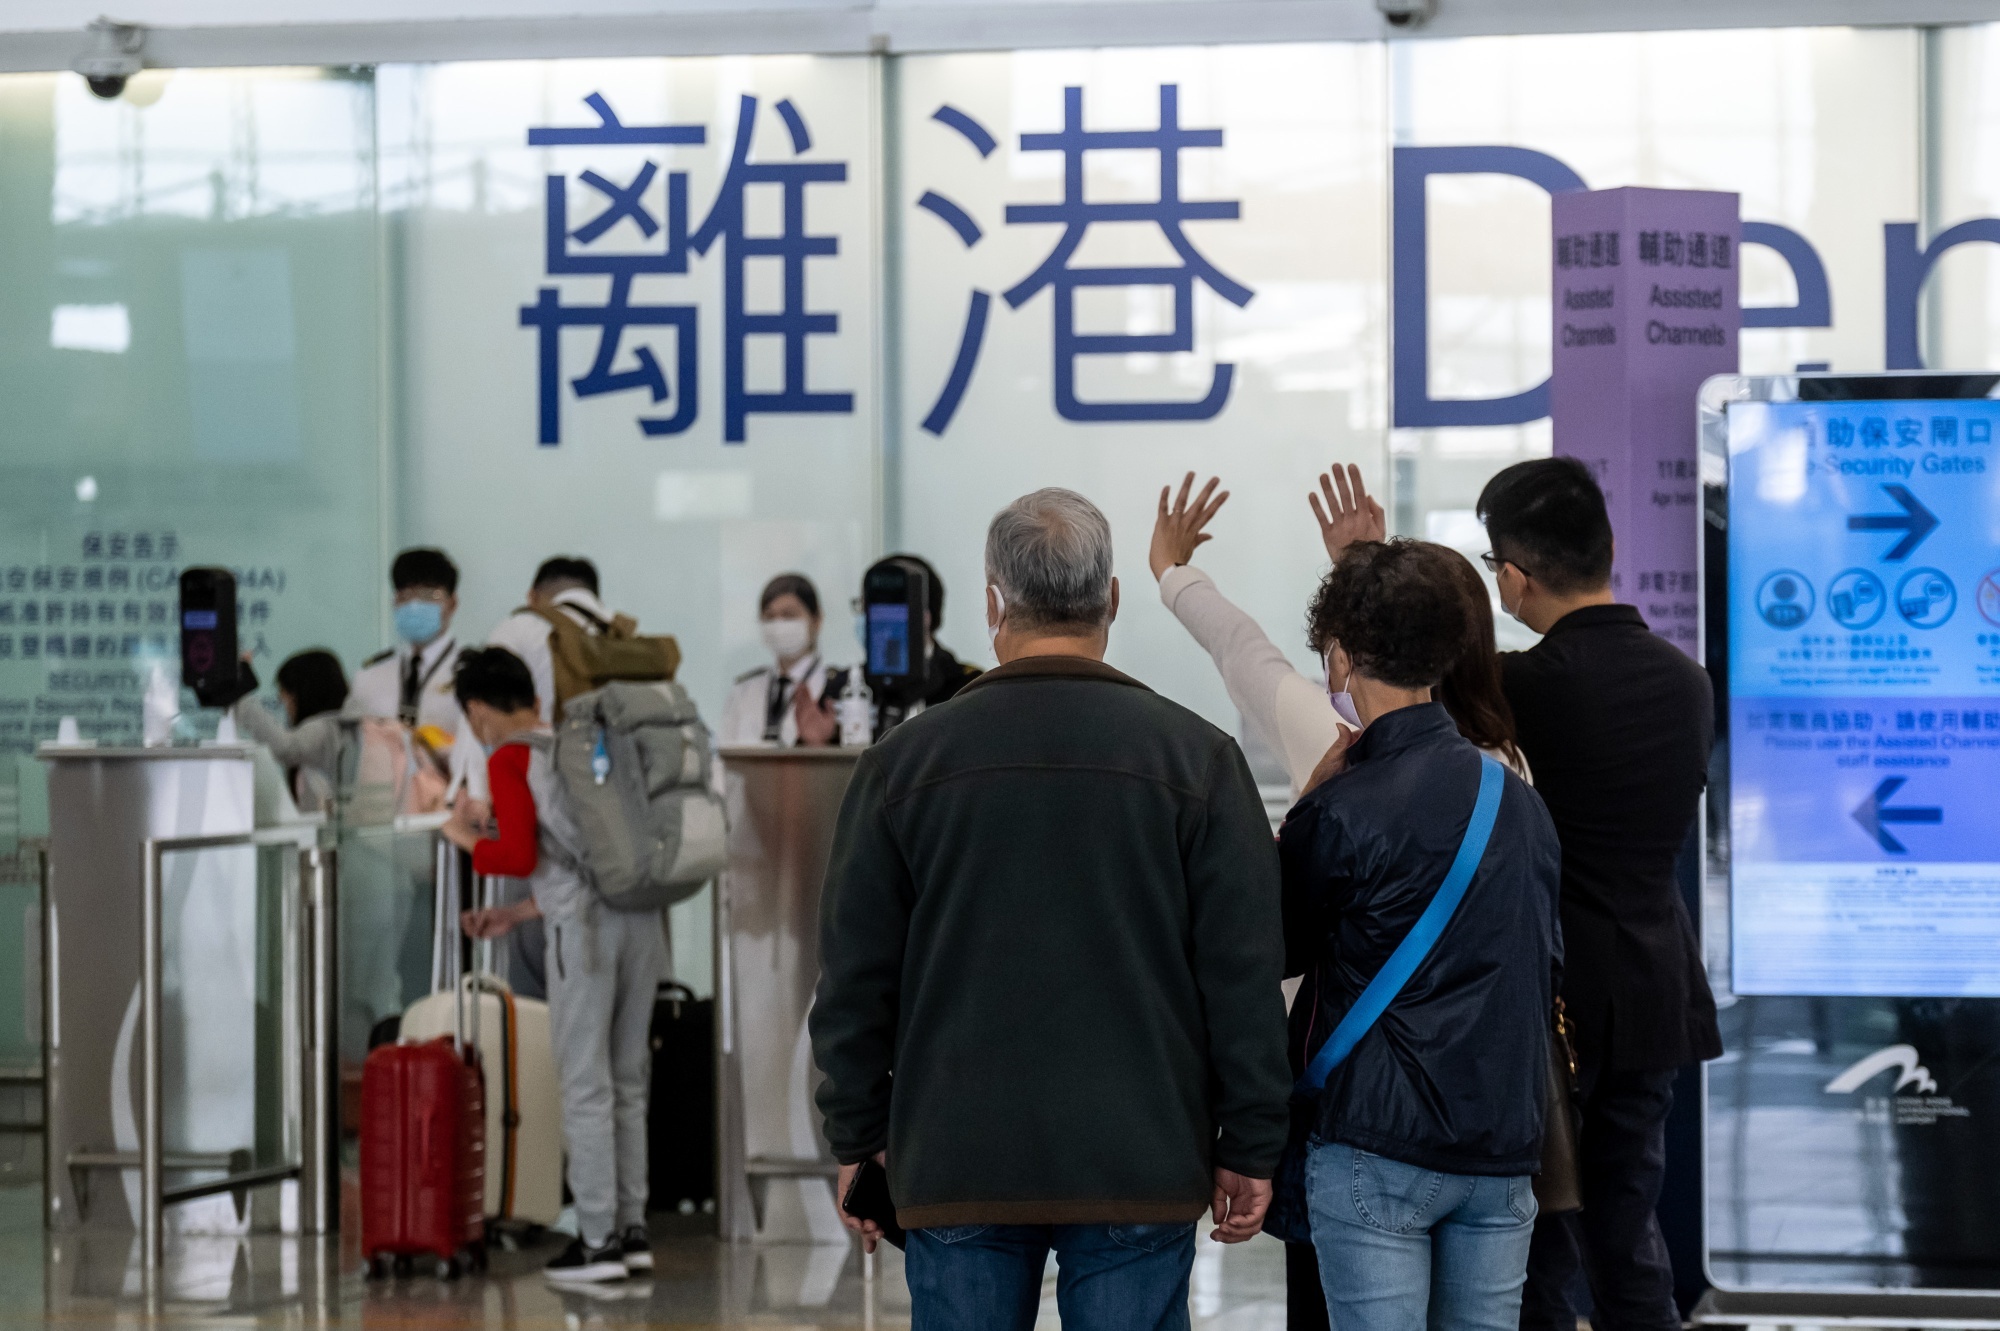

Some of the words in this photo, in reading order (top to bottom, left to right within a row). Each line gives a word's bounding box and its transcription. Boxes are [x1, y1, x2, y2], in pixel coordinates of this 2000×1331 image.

[520, 84, 1257, 446] 離港
[1652, 285, 1722, 309] Assisted
[1647, 320, 1725, 346] Channels
[1921, 454, 1986, 475] Gates
